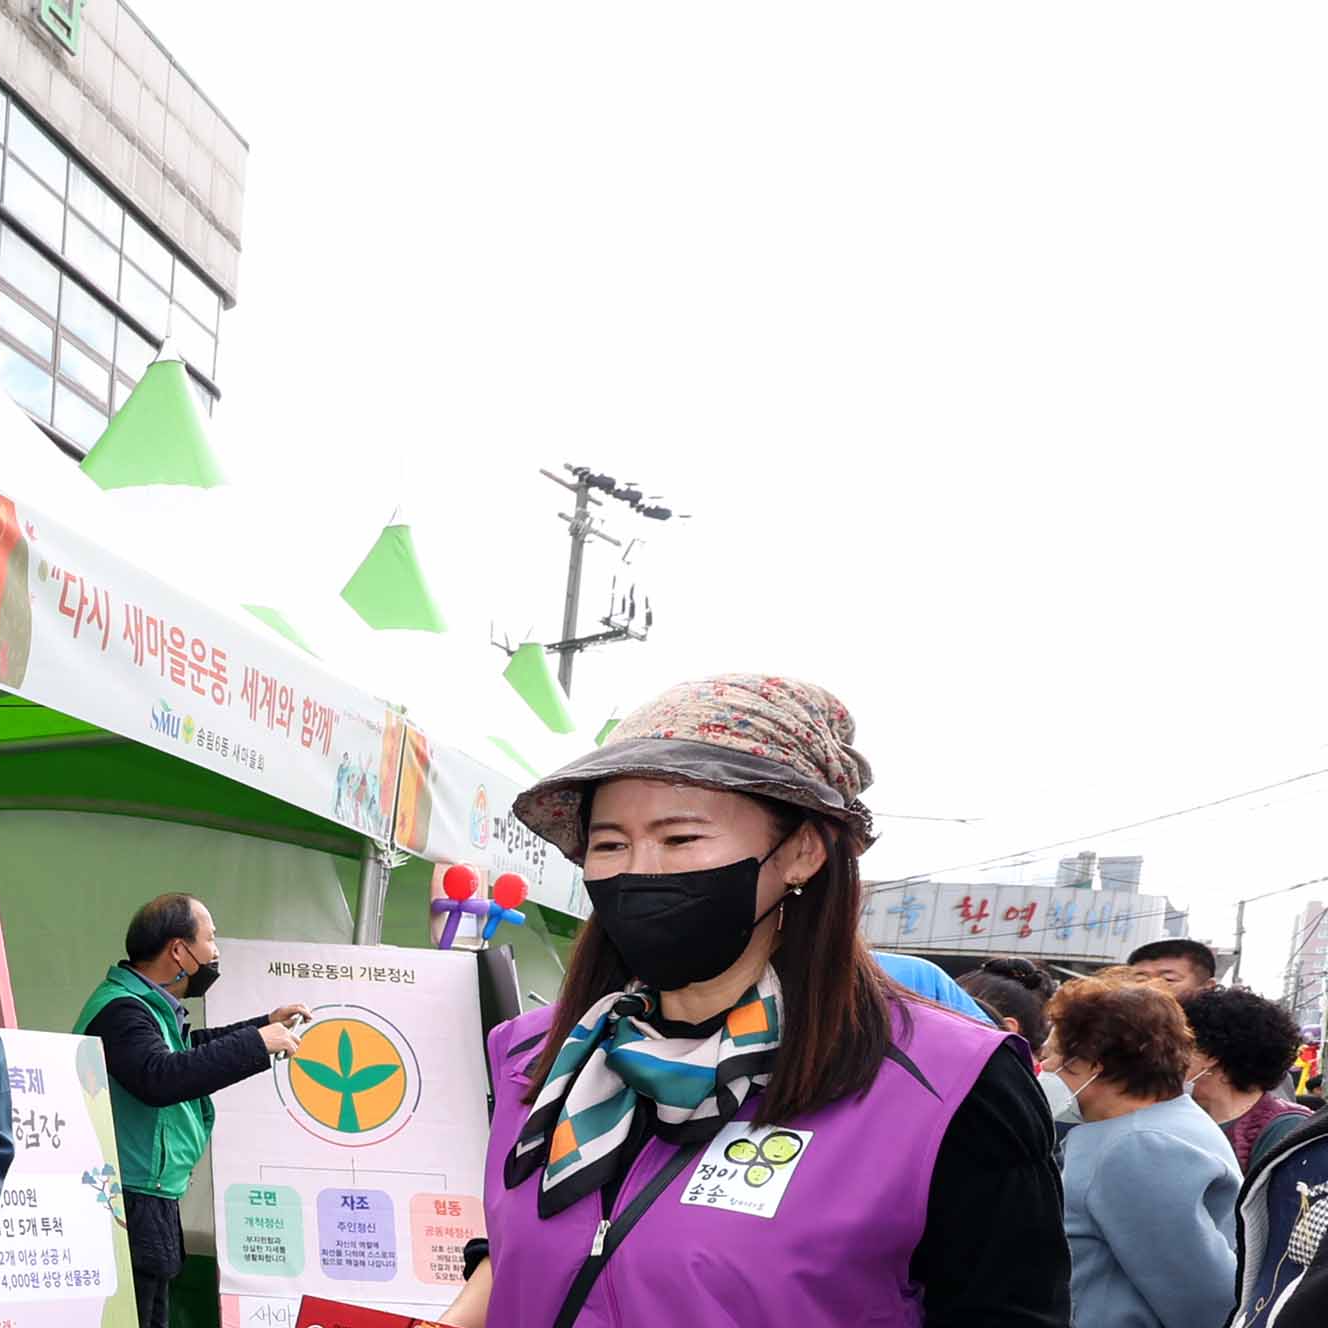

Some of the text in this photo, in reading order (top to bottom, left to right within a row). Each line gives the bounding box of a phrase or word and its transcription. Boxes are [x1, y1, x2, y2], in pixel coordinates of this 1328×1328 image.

[240, 665, 295, 739] 세계와
[268, 962, 416, 984] 새마을운동의 기본정신
[697, 1163, 739, 1182] 정이
[249, 1189, 277, 1206] 근면
[341, 1195, 370, 1211] 자조
[689, 1183, 728, 1204] 송송
[434, 1199, 462, 1216] 협동
[18, 1217, 38, 1237] 5개
[41, 1216, 64, 1236] 투척
[337, 1221, 376, 1234] 주인정신
[0, 1247, 72, 1266] 2개 이상 성공 시
[1, 1268, 102, 1291] 4,000원 상당 선물증정
